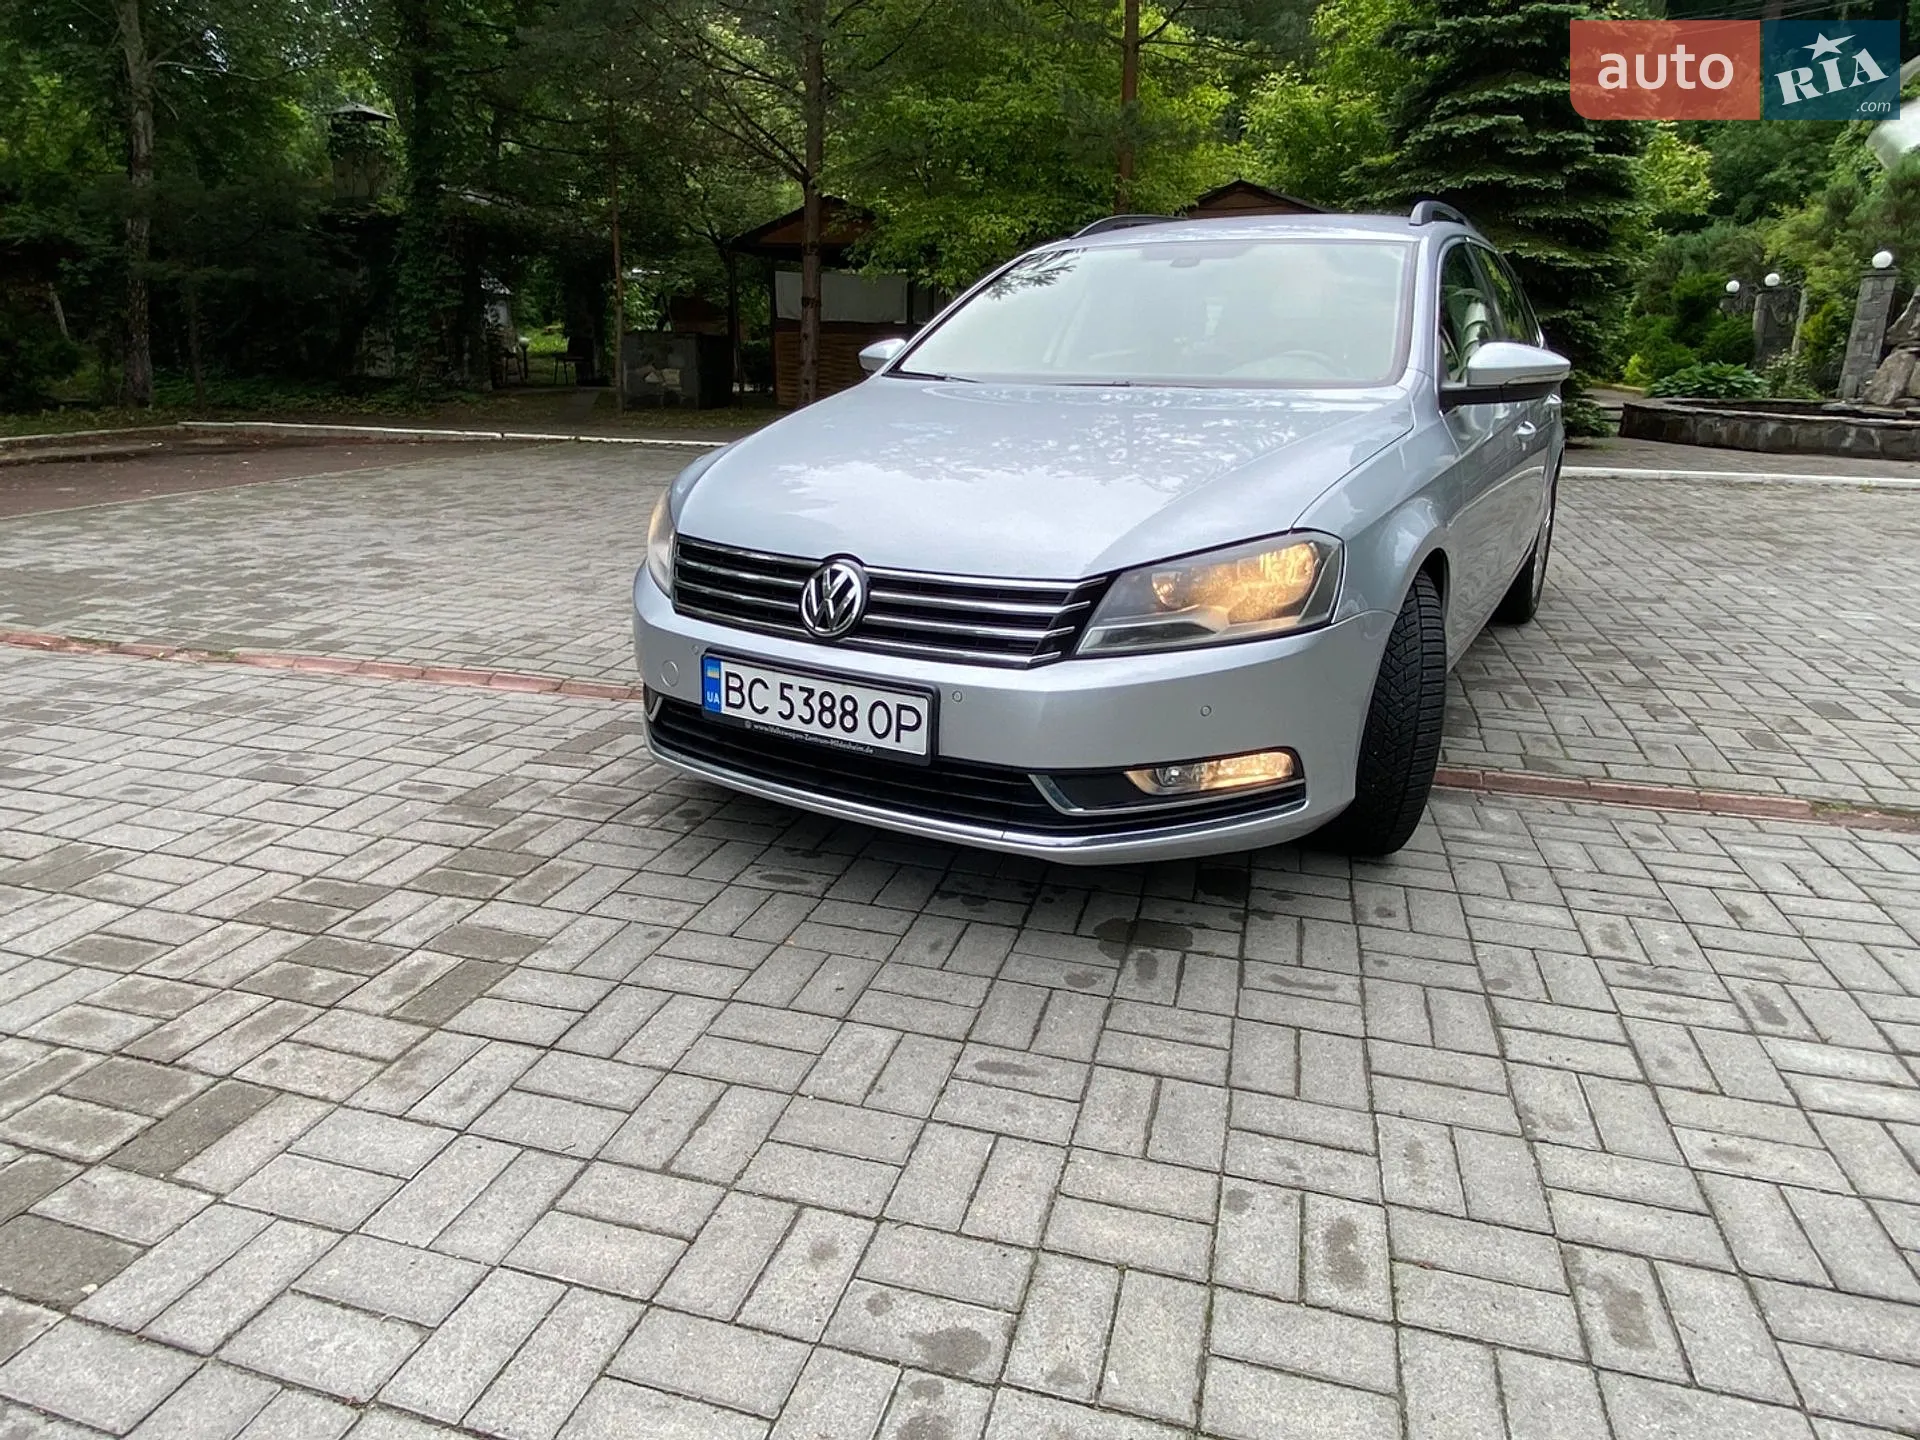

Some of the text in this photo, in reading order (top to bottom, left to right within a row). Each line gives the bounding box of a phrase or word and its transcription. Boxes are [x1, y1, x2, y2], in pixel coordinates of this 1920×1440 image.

[706, 691, 720, 705] UA
[725, 671, 922, 743] BC 5388 OP
